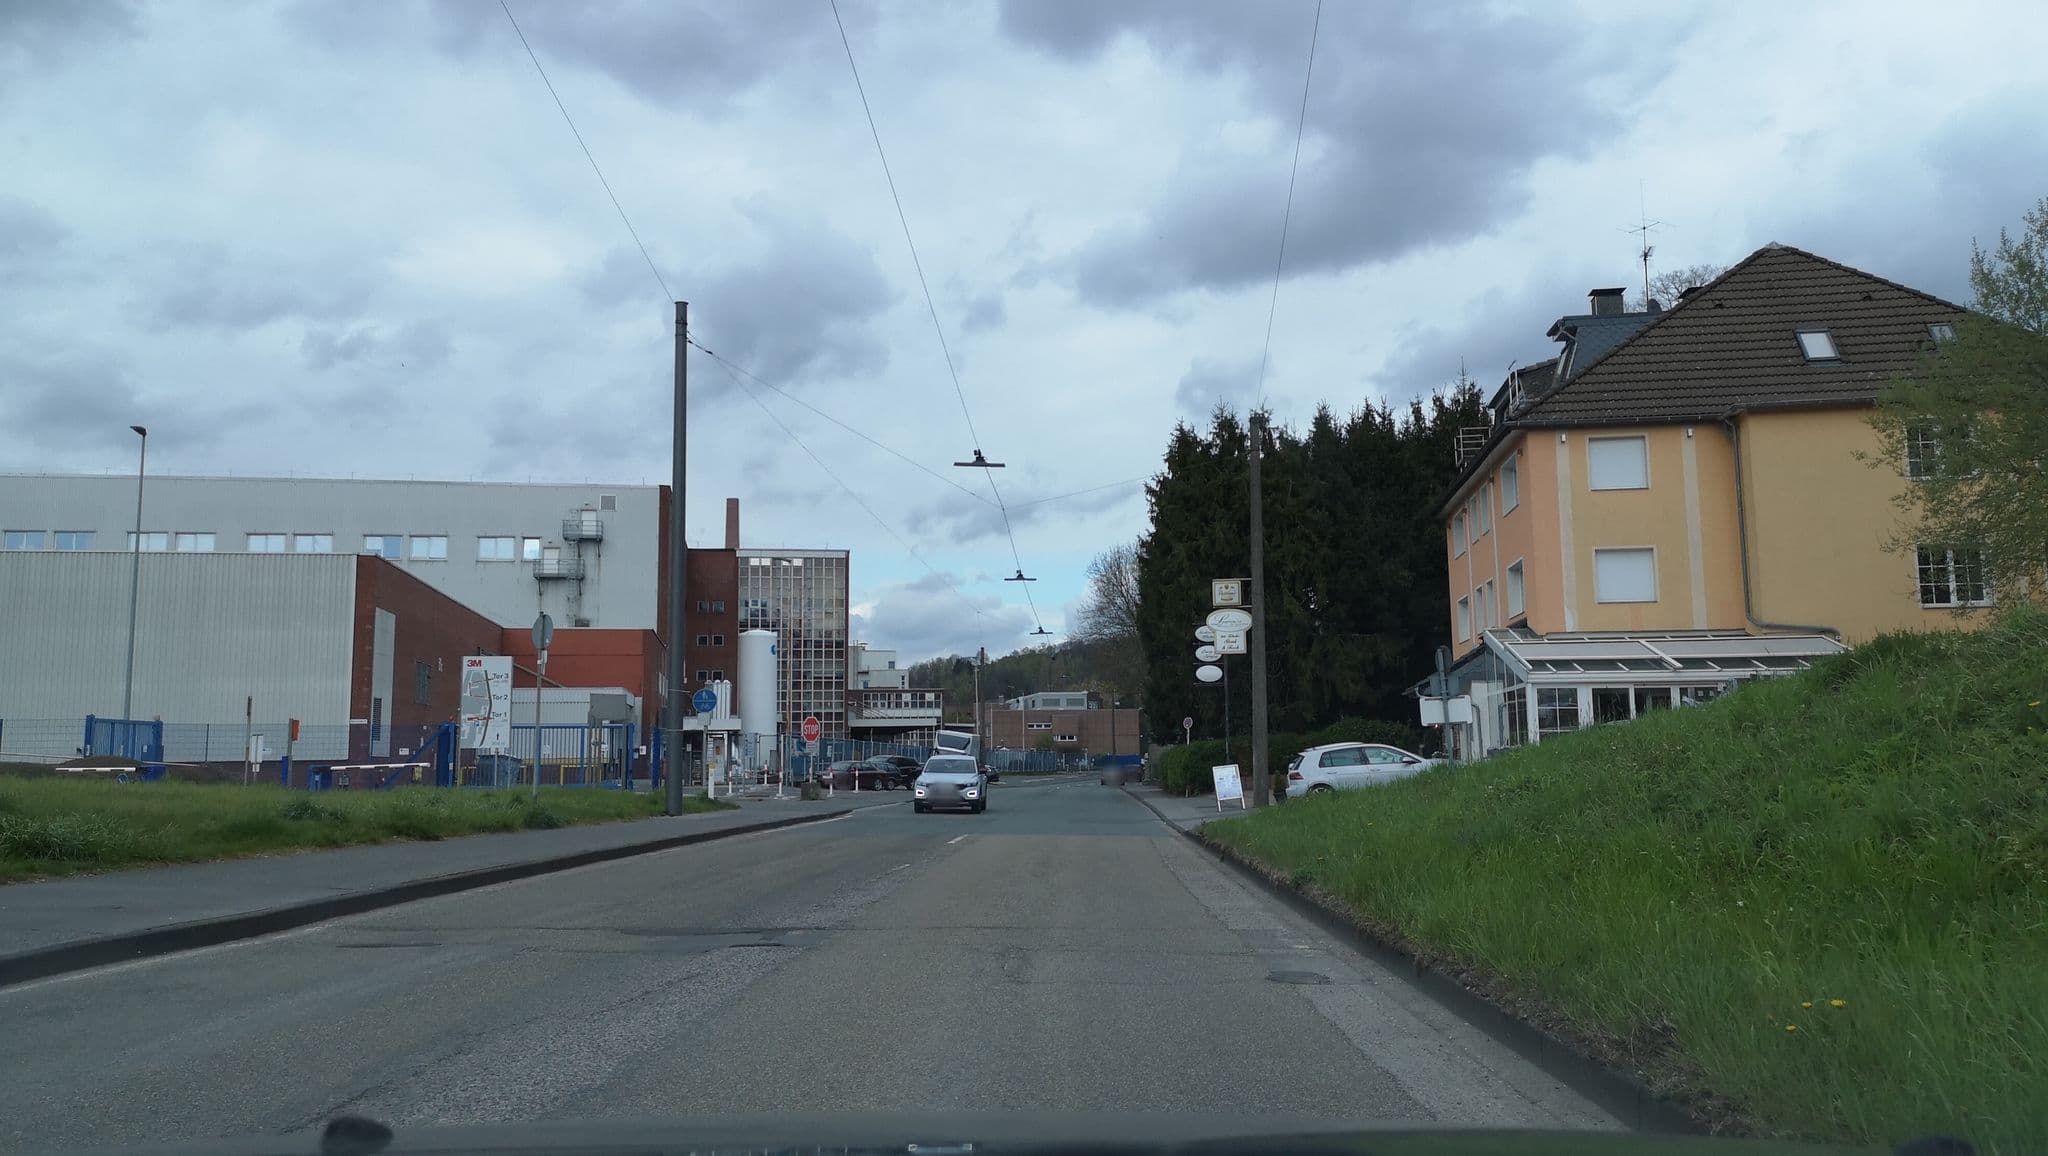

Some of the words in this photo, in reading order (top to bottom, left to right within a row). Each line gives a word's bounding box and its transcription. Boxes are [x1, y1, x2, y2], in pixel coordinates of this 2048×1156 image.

[467, 660, 482, 668] 3M
[492, 672, 503, 680] Tor
[804, 724, 819, 735] STOP
